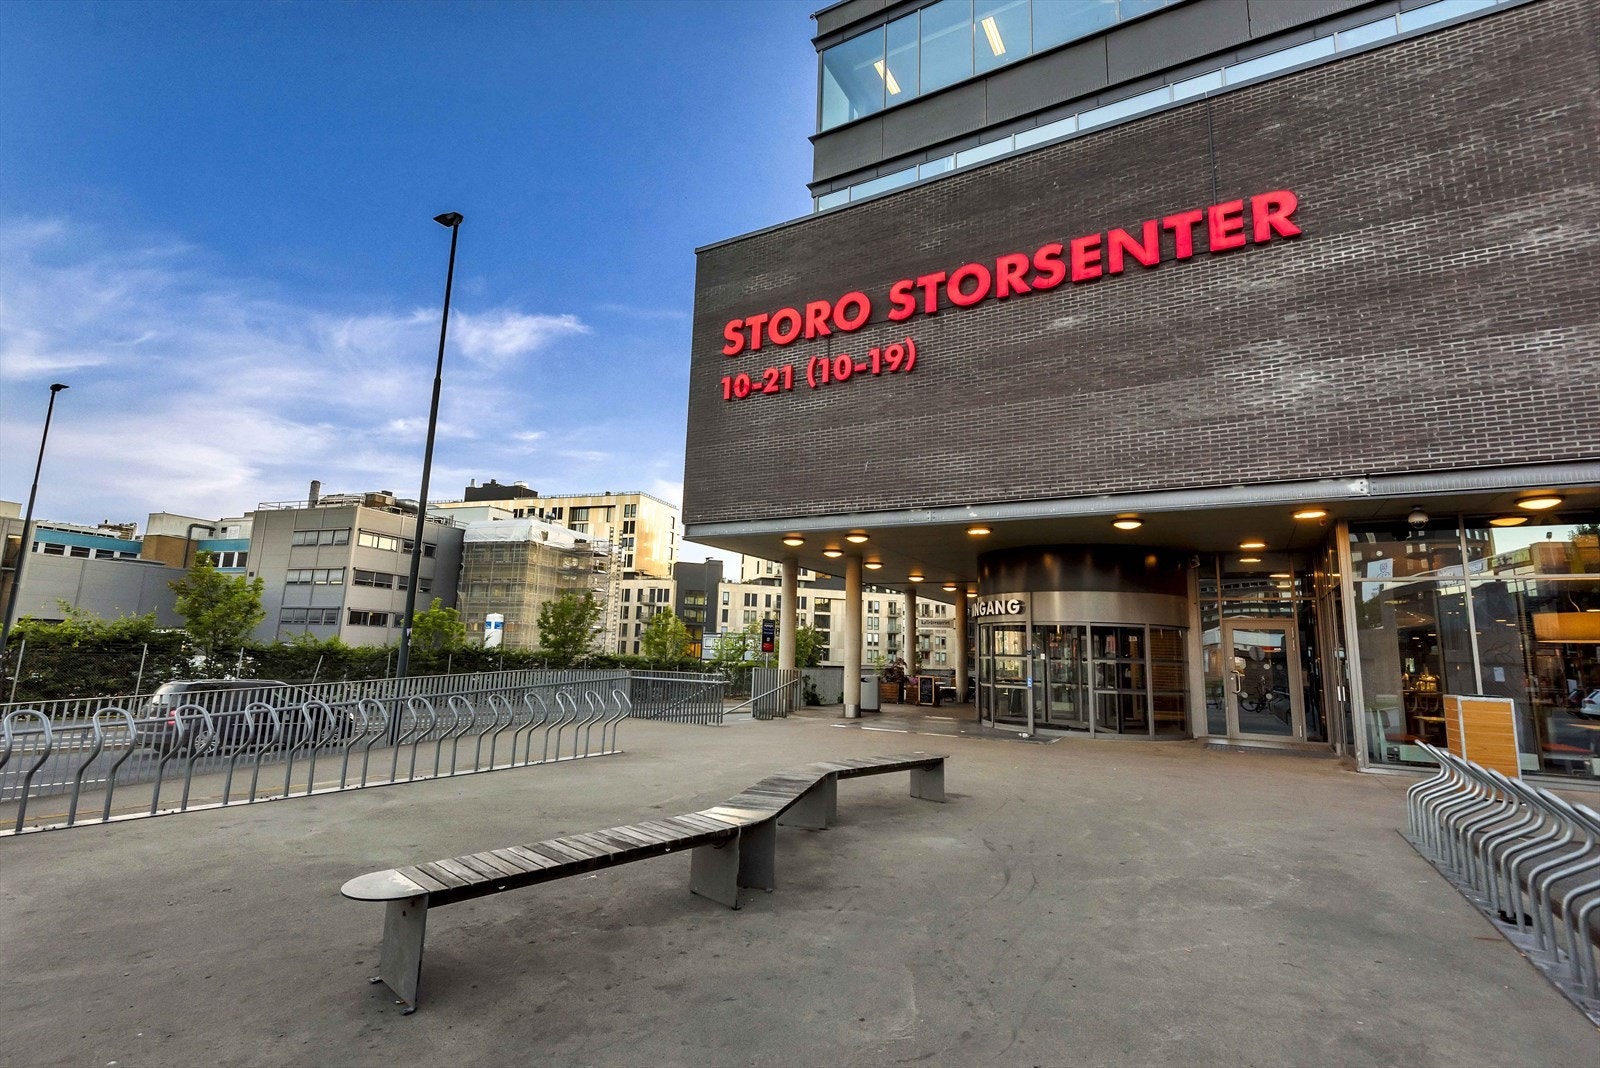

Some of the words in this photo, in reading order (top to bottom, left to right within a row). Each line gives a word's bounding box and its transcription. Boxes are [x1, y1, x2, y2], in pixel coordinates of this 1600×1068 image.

[722, 291, 872, 357] STORO
[888, 190, 1302, 322] STORSENTER
[720, 365, 794, 401] 10-21
[806, 336, 917, 388] (10-19)
